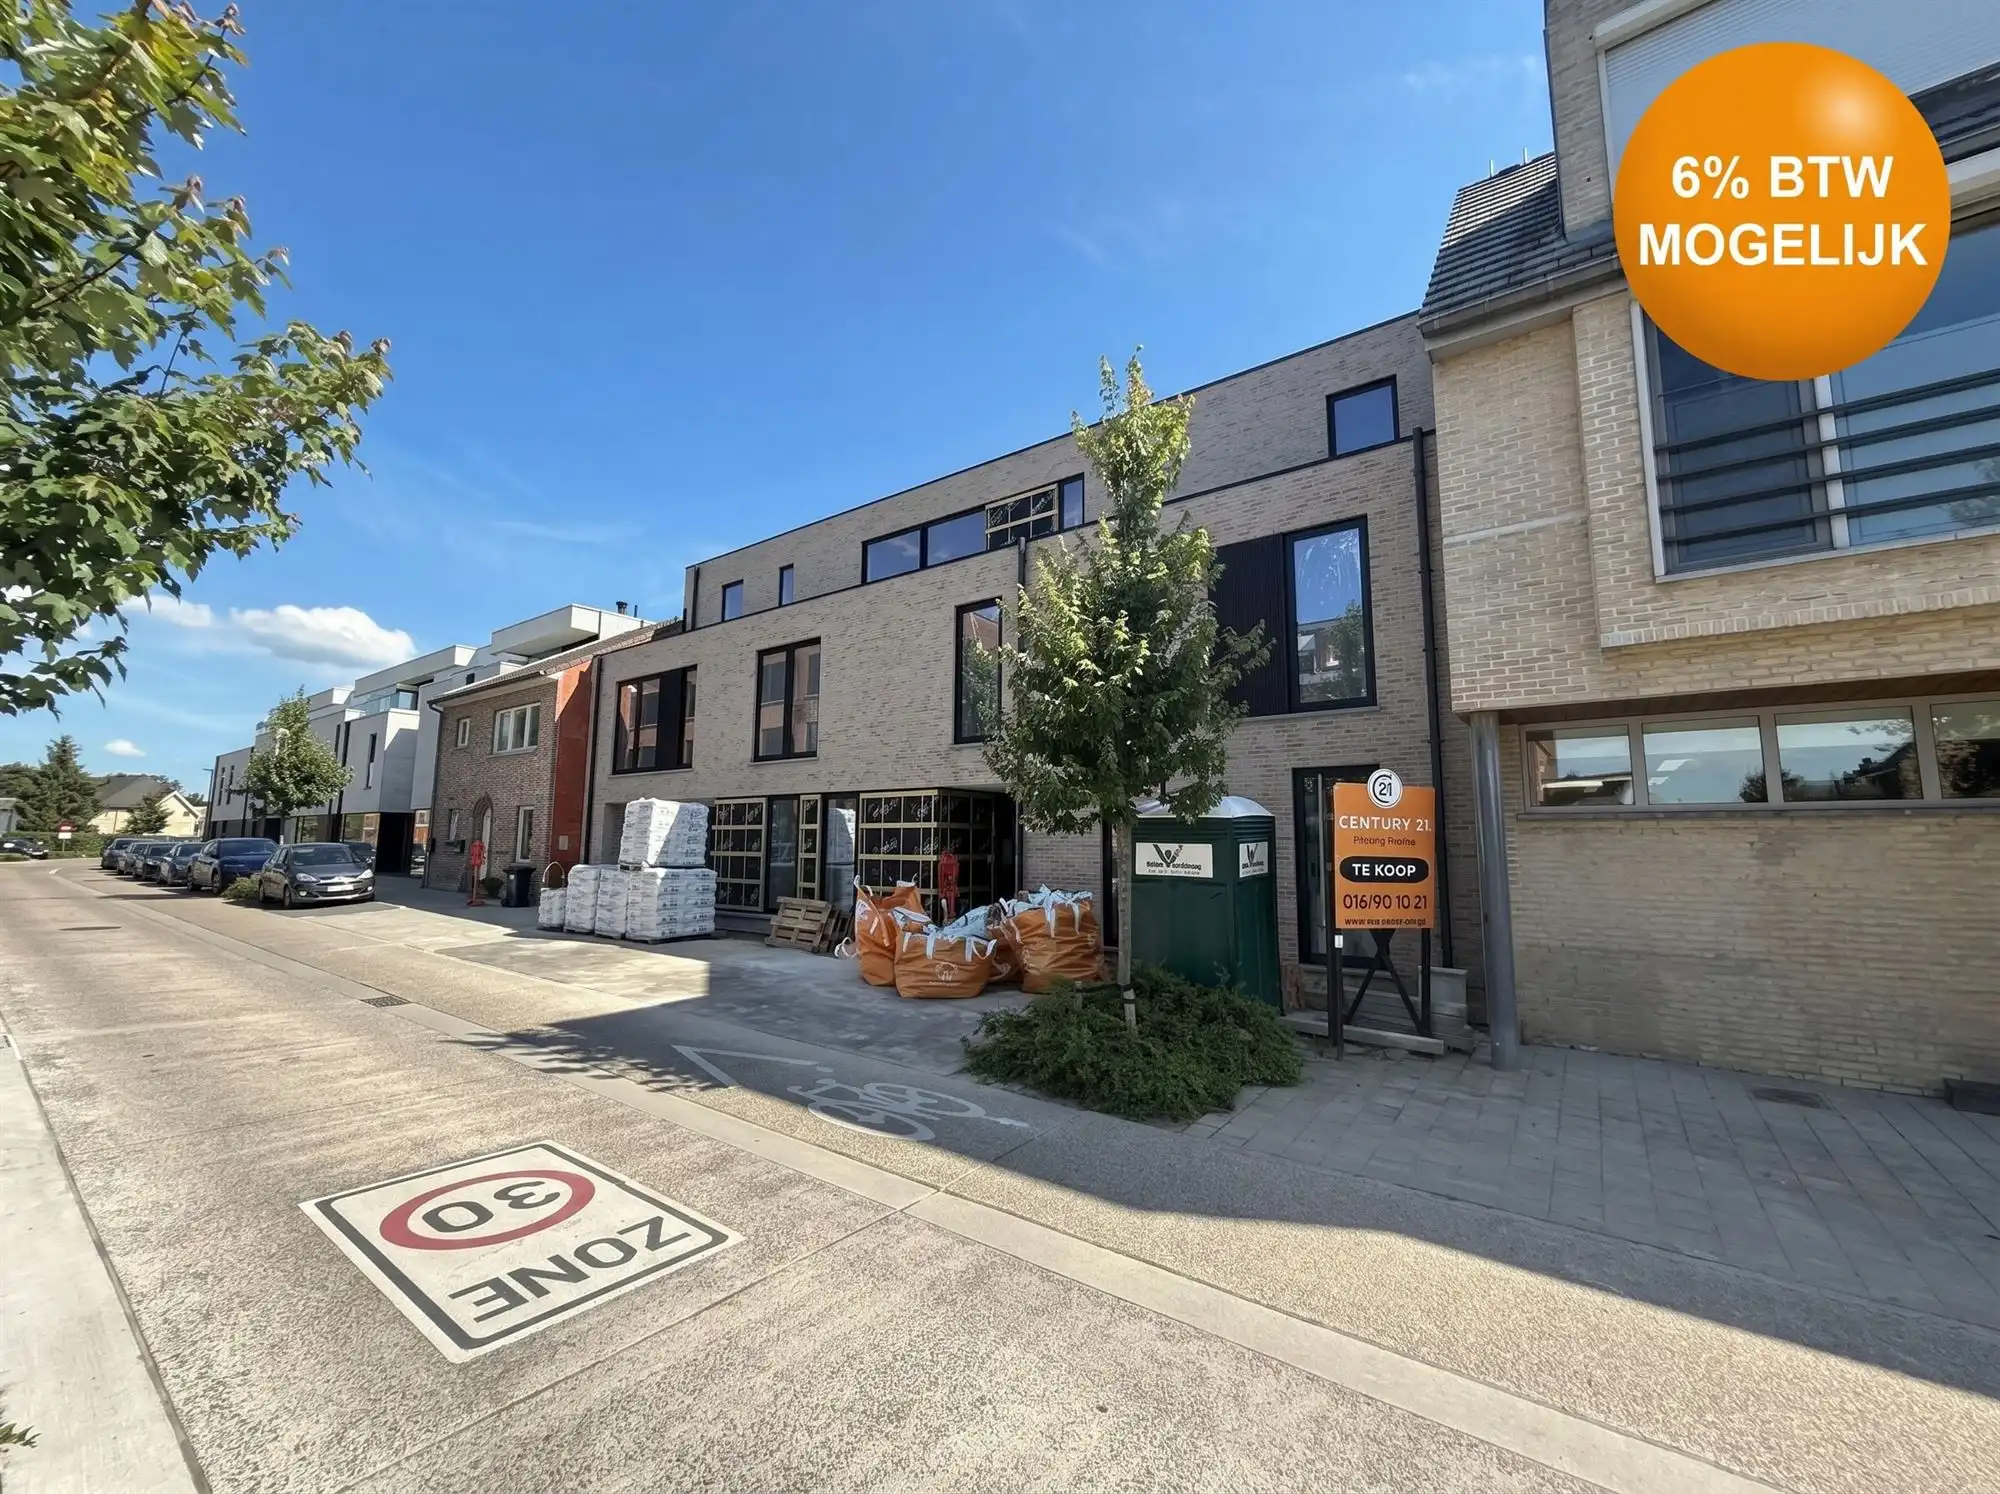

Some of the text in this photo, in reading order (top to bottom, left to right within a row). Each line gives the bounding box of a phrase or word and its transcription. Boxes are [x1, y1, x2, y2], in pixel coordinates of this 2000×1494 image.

[1338, 815, 1411, 831] CENTURY
[1352, 863, 1416, 877] TE KOOP
[1343, 894, 1428, 910] 016/90 10 21
[421, 1180, 561, 1234] 30
[449, 1215, 692, 1324] ZONE
